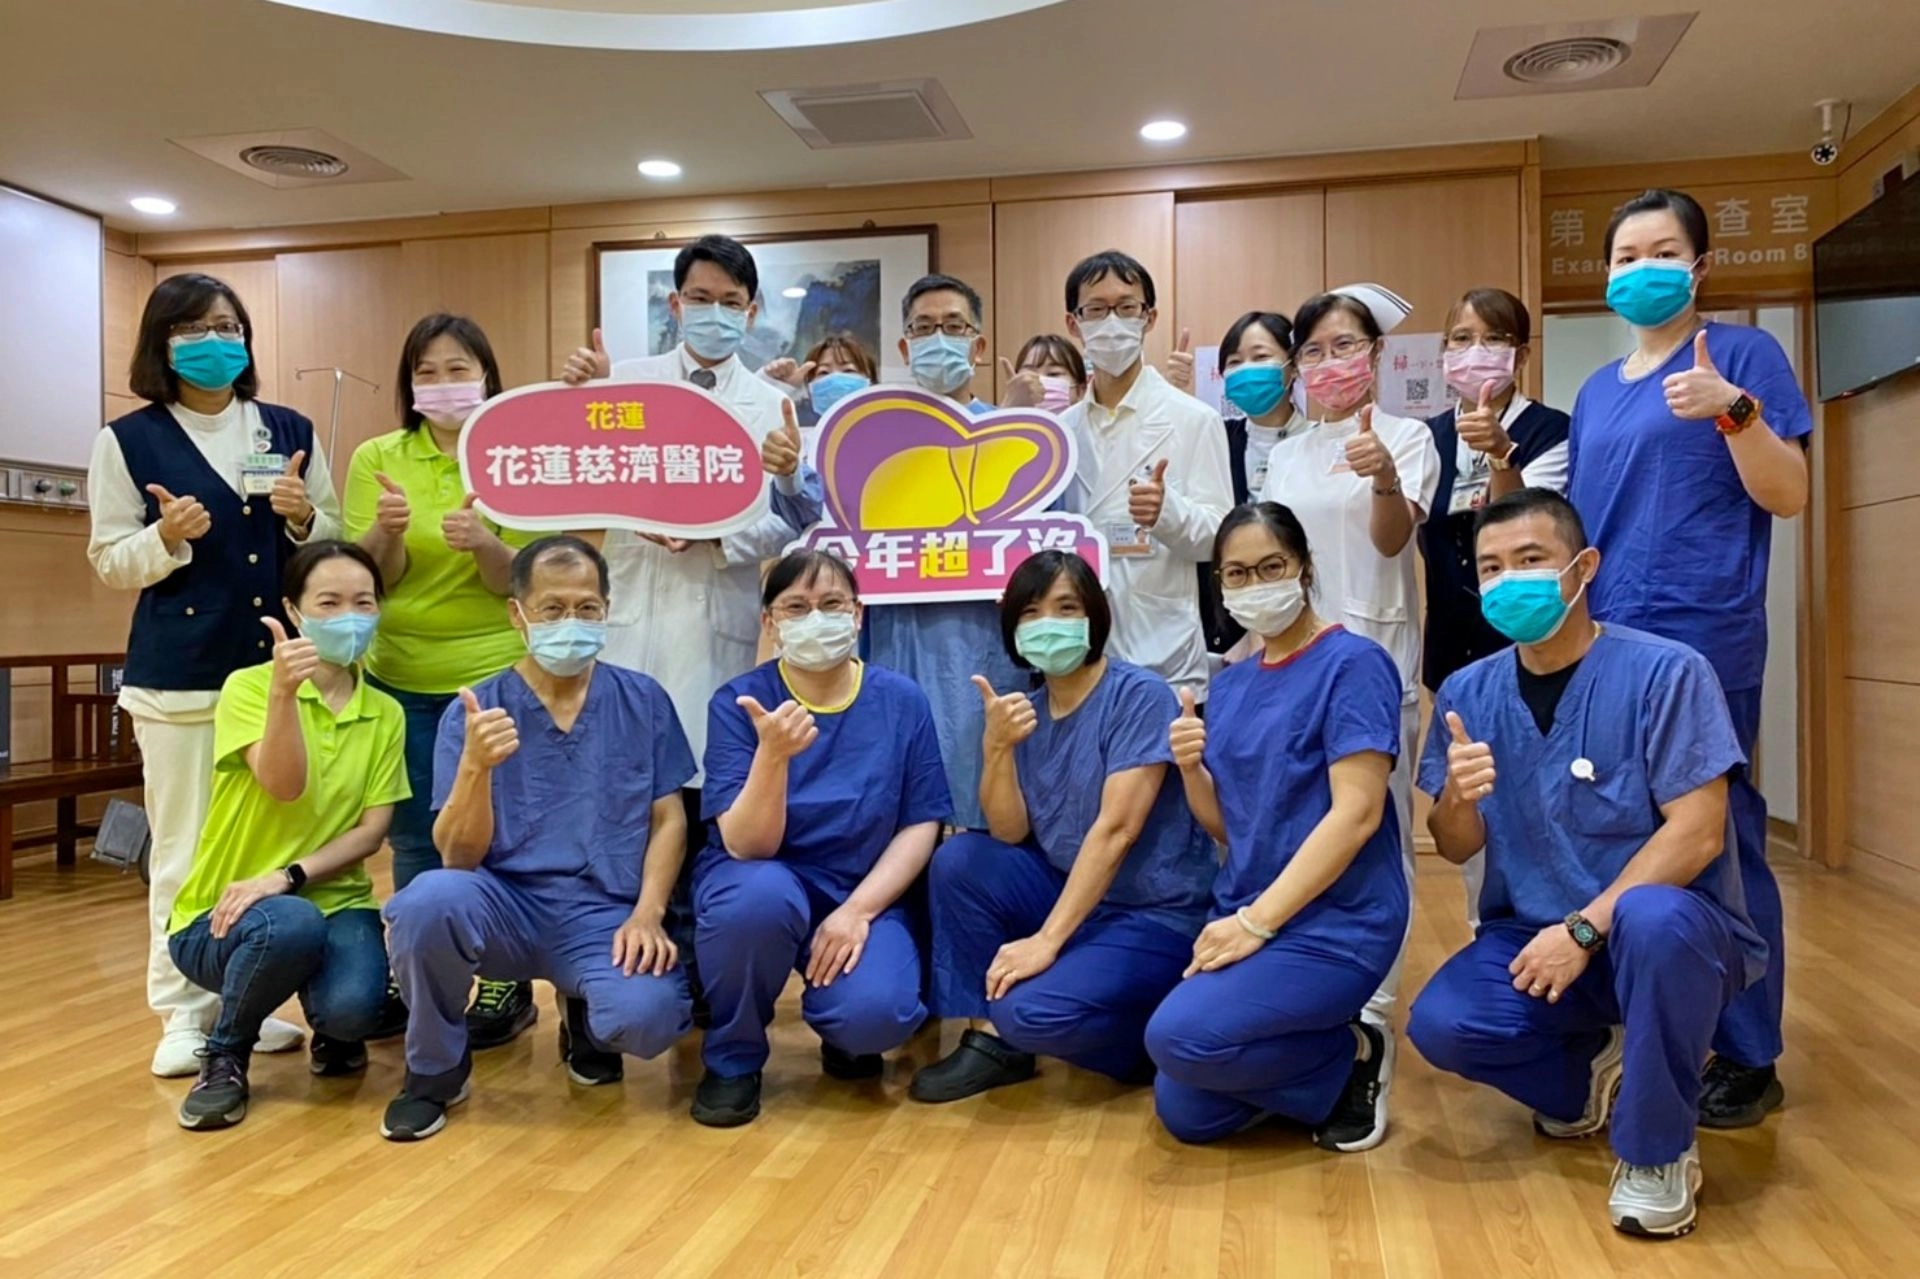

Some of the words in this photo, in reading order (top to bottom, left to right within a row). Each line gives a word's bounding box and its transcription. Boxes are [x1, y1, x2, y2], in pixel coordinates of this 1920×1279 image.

[1715, 248, 1786, 265] Room
[586, 402, 645, 430] 花蓮
[485, 444, 745, 486] 花蓮慈濟醫院
